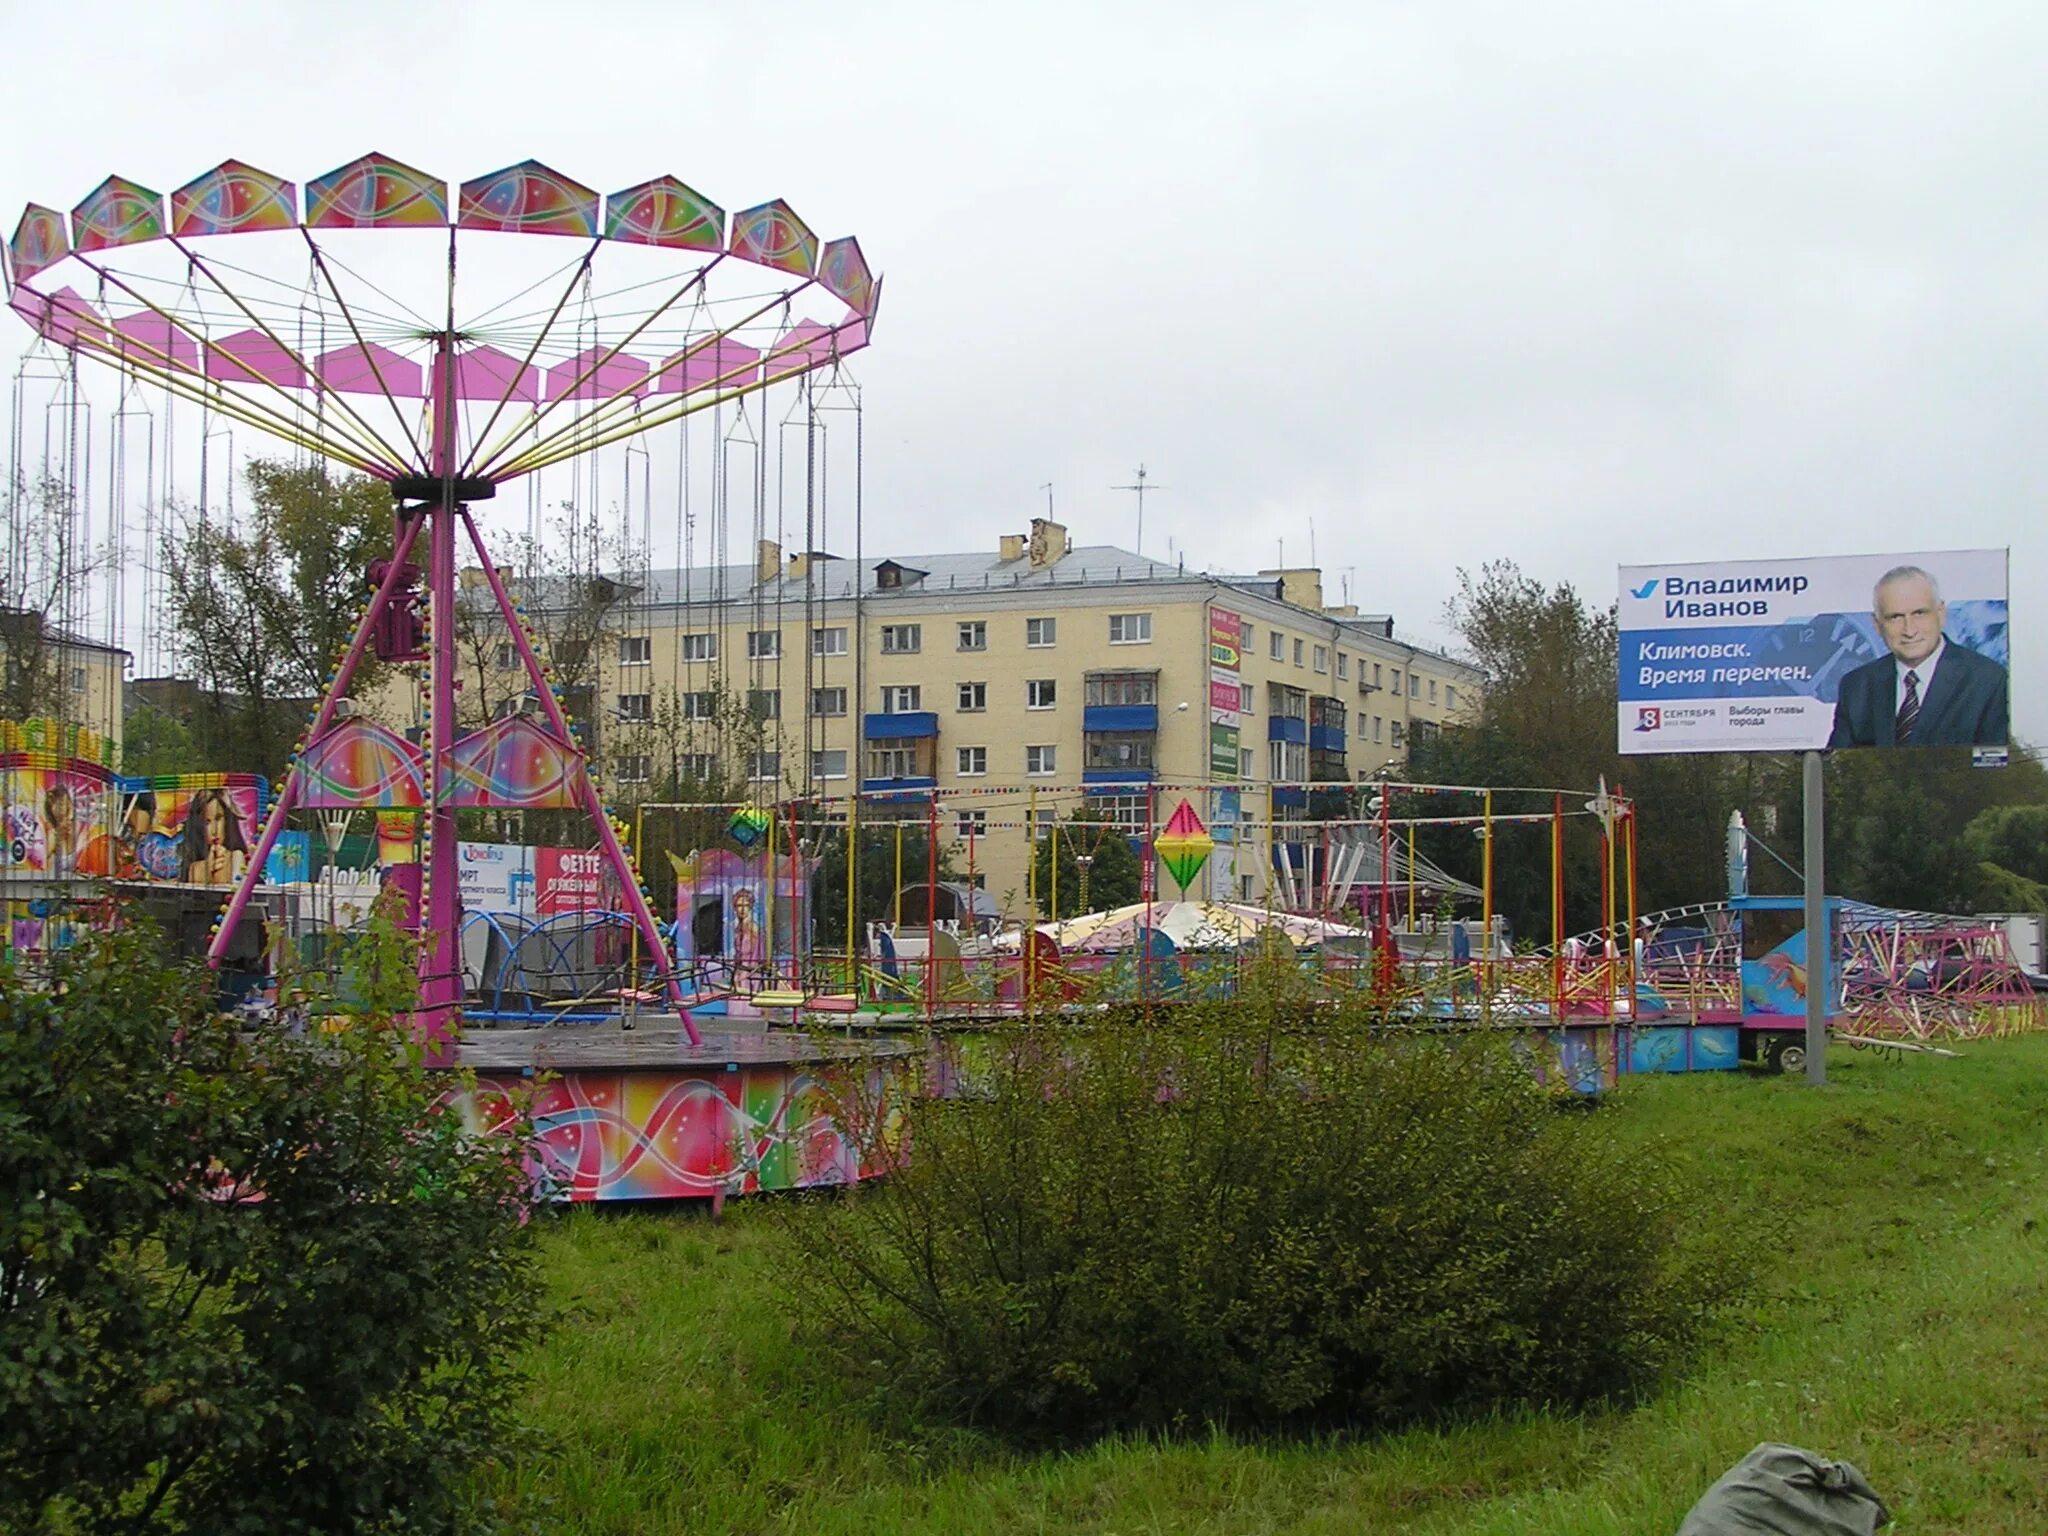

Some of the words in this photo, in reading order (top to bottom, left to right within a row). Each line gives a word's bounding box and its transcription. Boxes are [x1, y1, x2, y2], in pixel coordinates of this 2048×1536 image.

[1665, 576, 1808, 596] Владимир
[1665, 600, 1768, 618] Иванов
[1638, 642, 1751, 660] Климовск.
[1638, 666, 1706, 688] Время
[1712, 665, 1812, 686] перемен.
[1644, 710, 1657, 728] 8
[1663, 709, 1716, 719] СЕНТЯБРЯ
[1729, 706, 1771, 717] Выборы
[1773, 706, 1805, 715] главы
[1729, 717, 1766, 727] города
